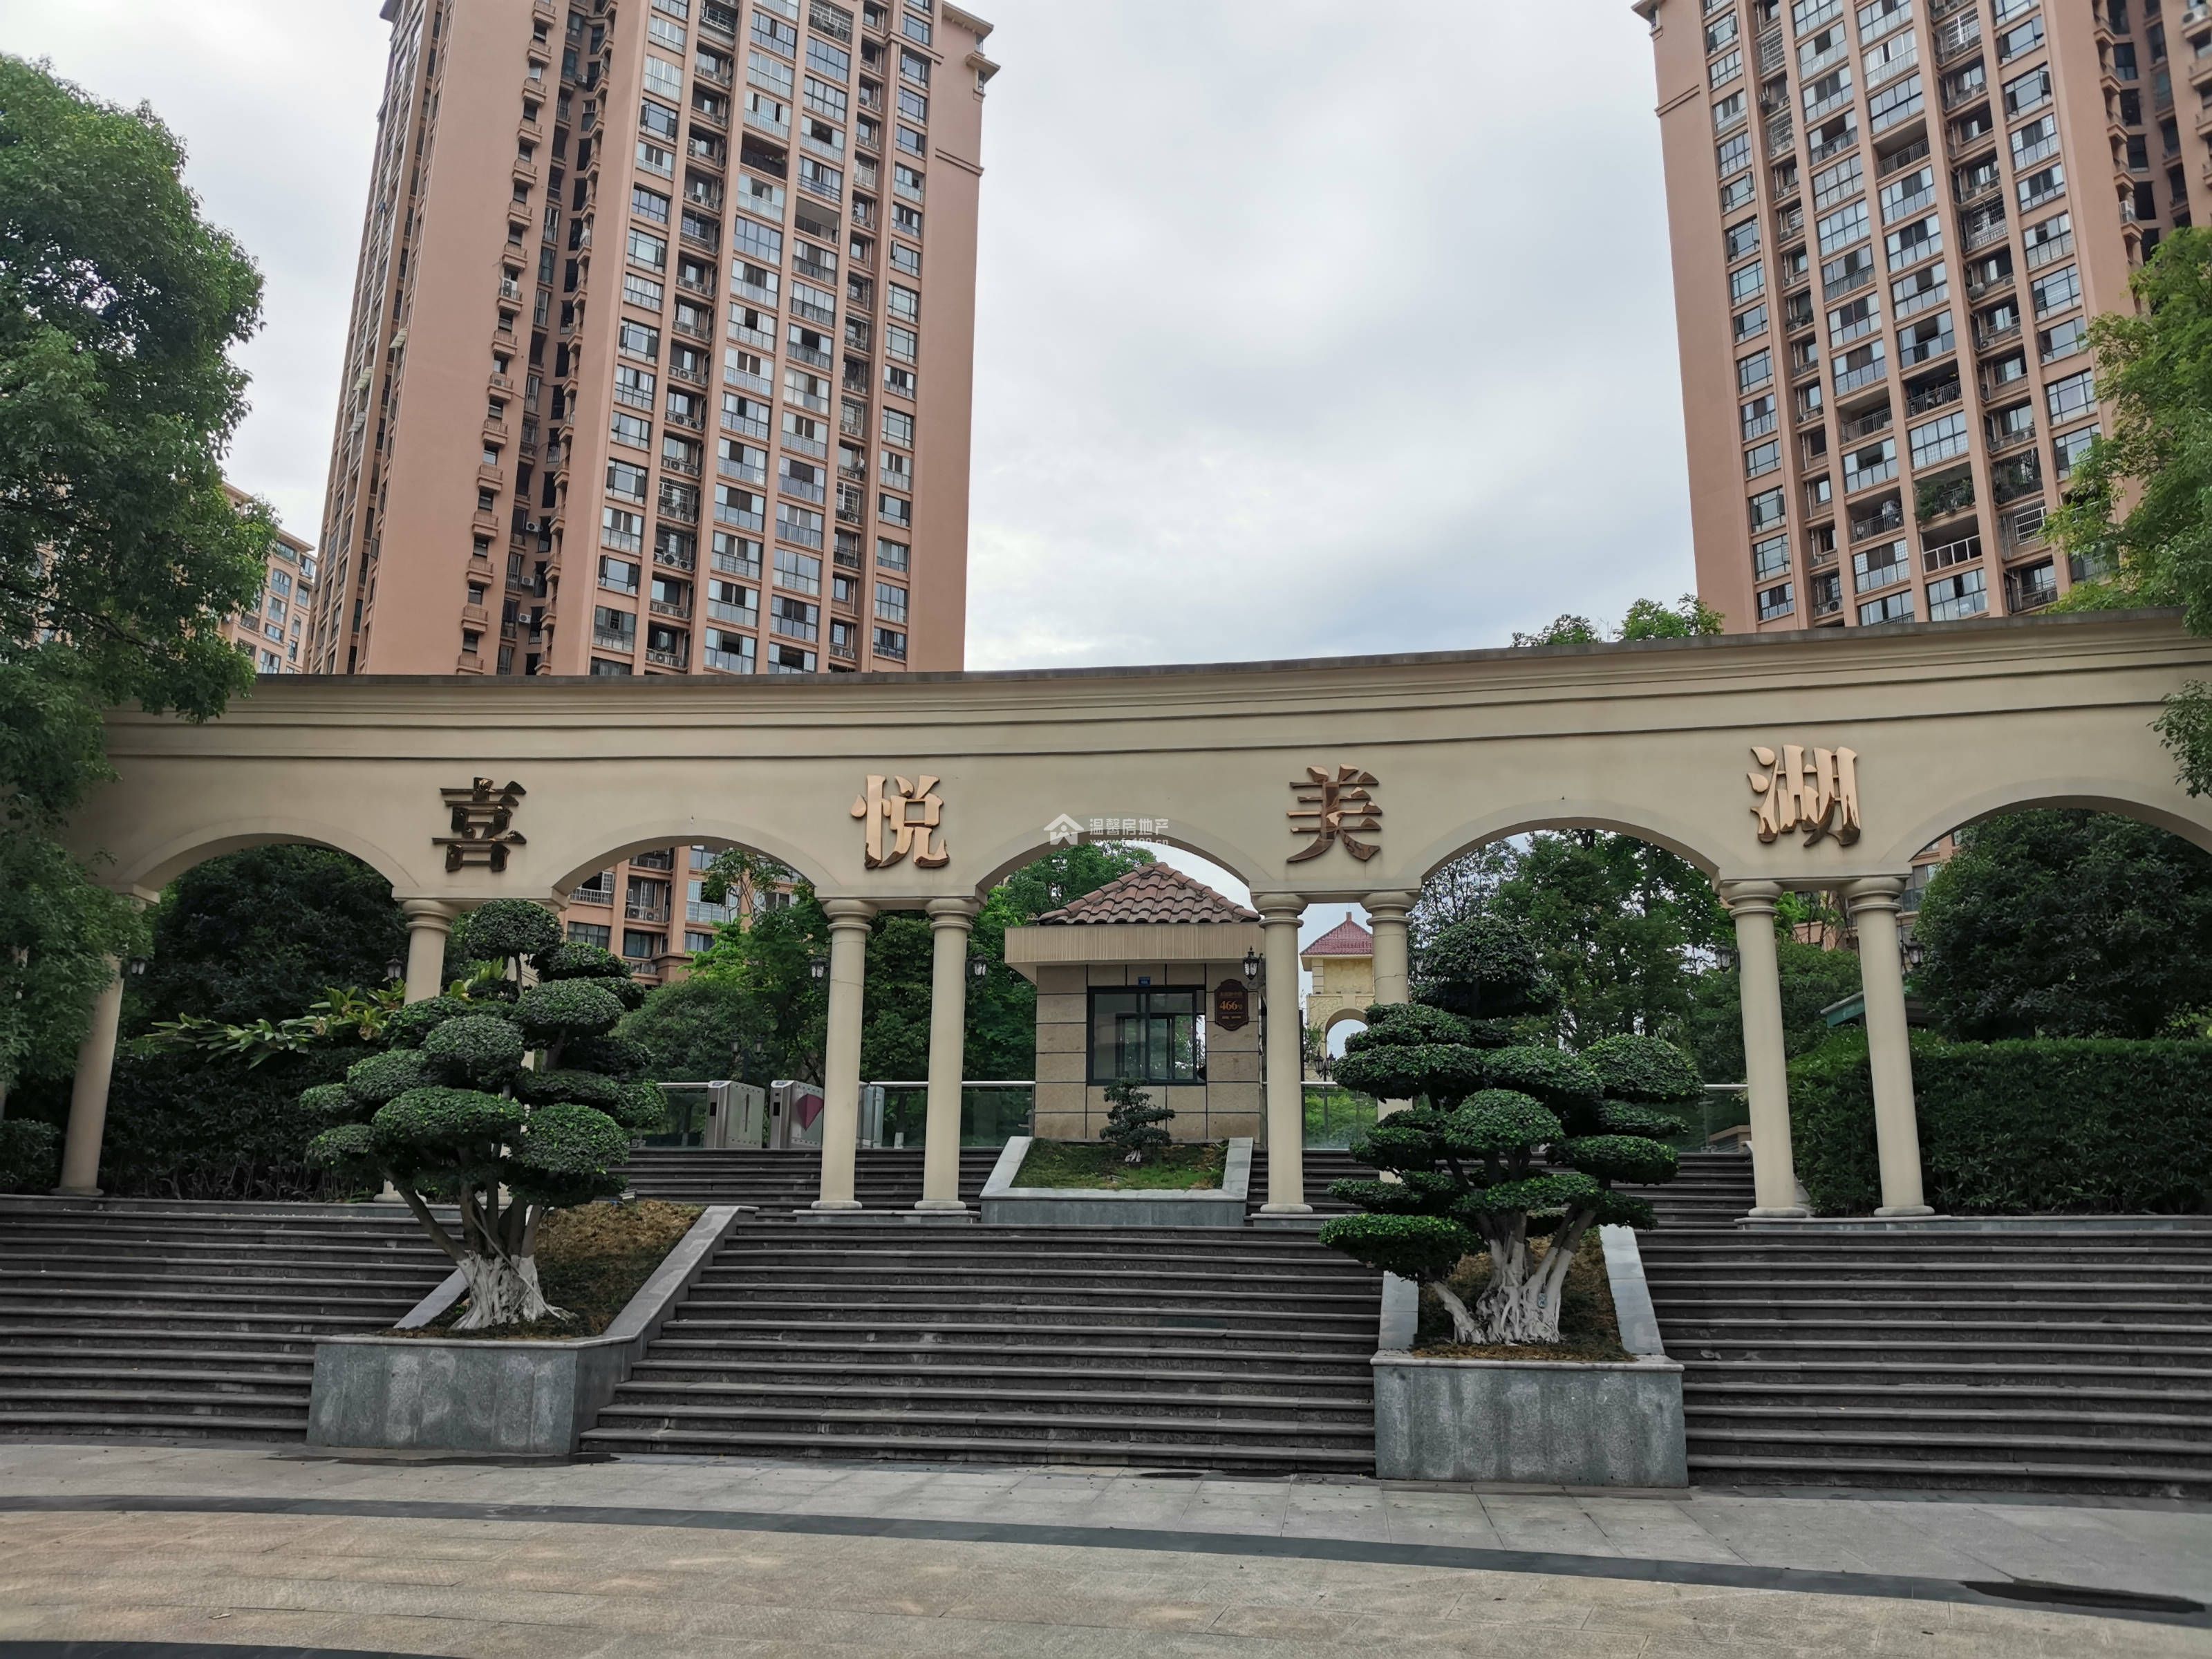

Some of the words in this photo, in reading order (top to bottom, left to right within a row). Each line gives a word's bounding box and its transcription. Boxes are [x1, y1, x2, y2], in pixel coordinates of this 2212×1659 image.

[432, 777, 527, 872] 喜
[850, 774, 950, 869] 悦
[1286, 763, 1383, 864] 美
[1747, 744, 1861, 847] 湖
